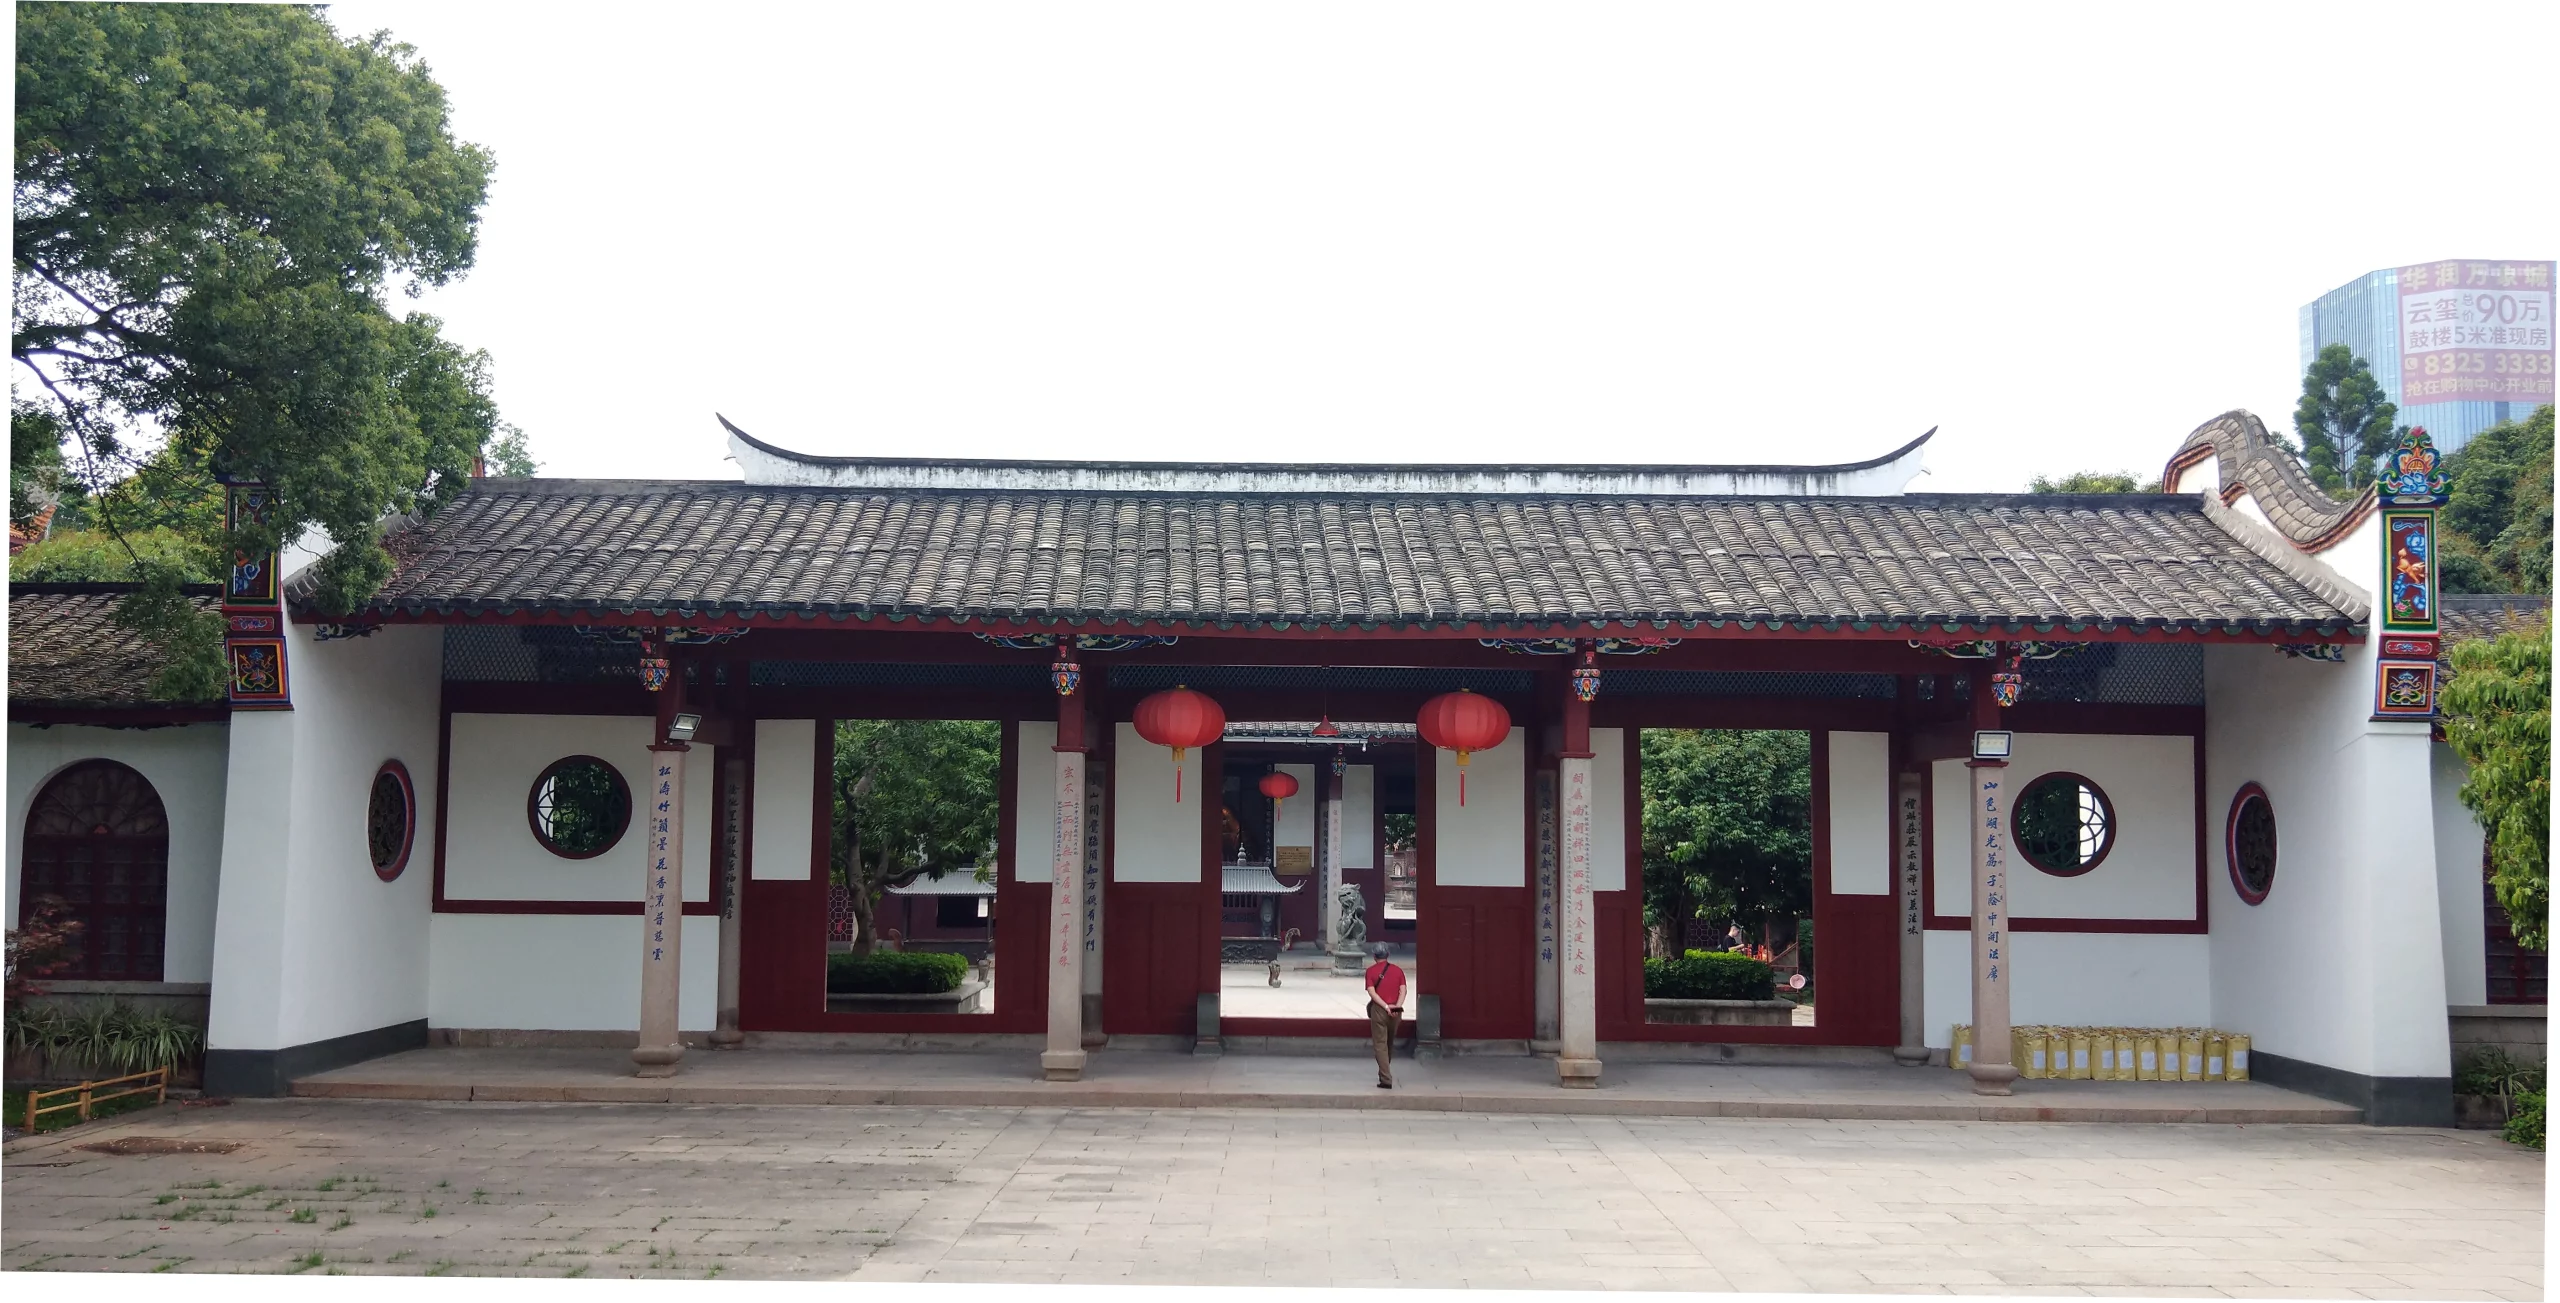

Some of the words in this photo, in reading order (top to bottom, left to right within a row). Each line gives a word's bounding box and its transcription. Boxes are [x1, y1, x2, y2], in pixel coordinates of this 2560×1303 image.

[2408, 326, 2548, 349] 鼓楼5米准现房
[2424, 352, 2486, 376] 8325
[2494, 353, 2553, 375] 3333
[2405, 377, 2553, 397] 抢在购物中心开业前
